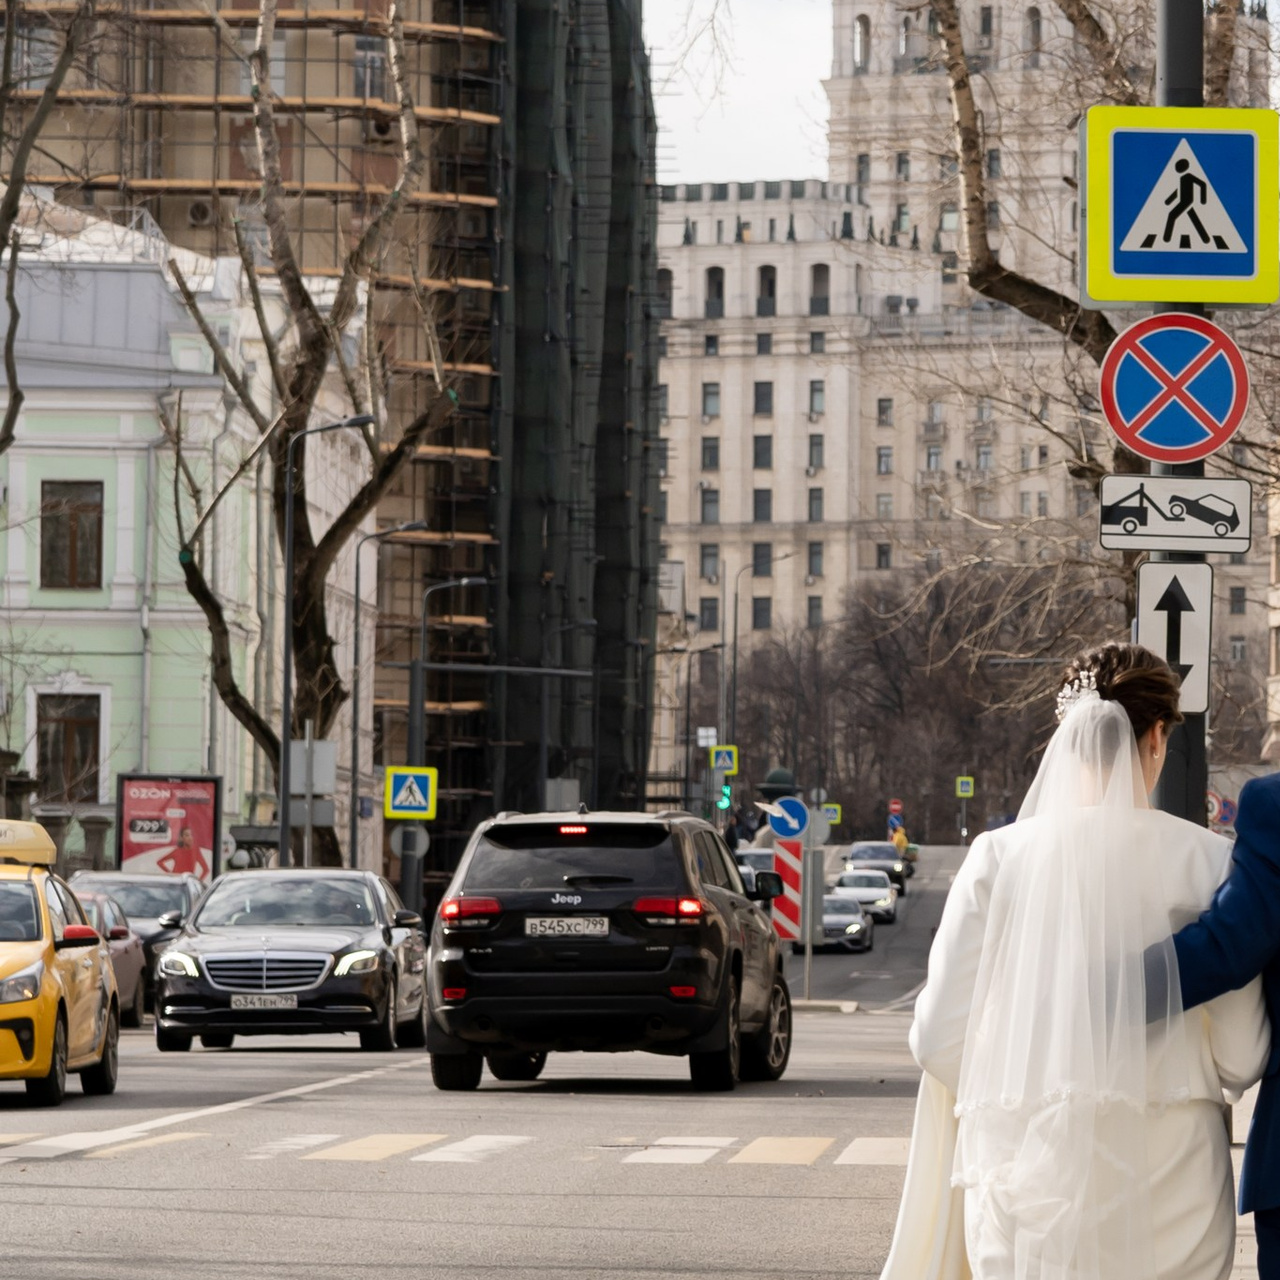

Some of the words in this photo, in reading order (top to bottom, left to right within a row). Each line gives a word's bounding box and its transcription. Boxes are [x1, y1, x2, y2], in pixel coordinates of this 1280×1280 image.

[129, 787, 171, 799] OZON
[551, 893, 582, 905] Jeep
[585, 919, 605, 930] 799
